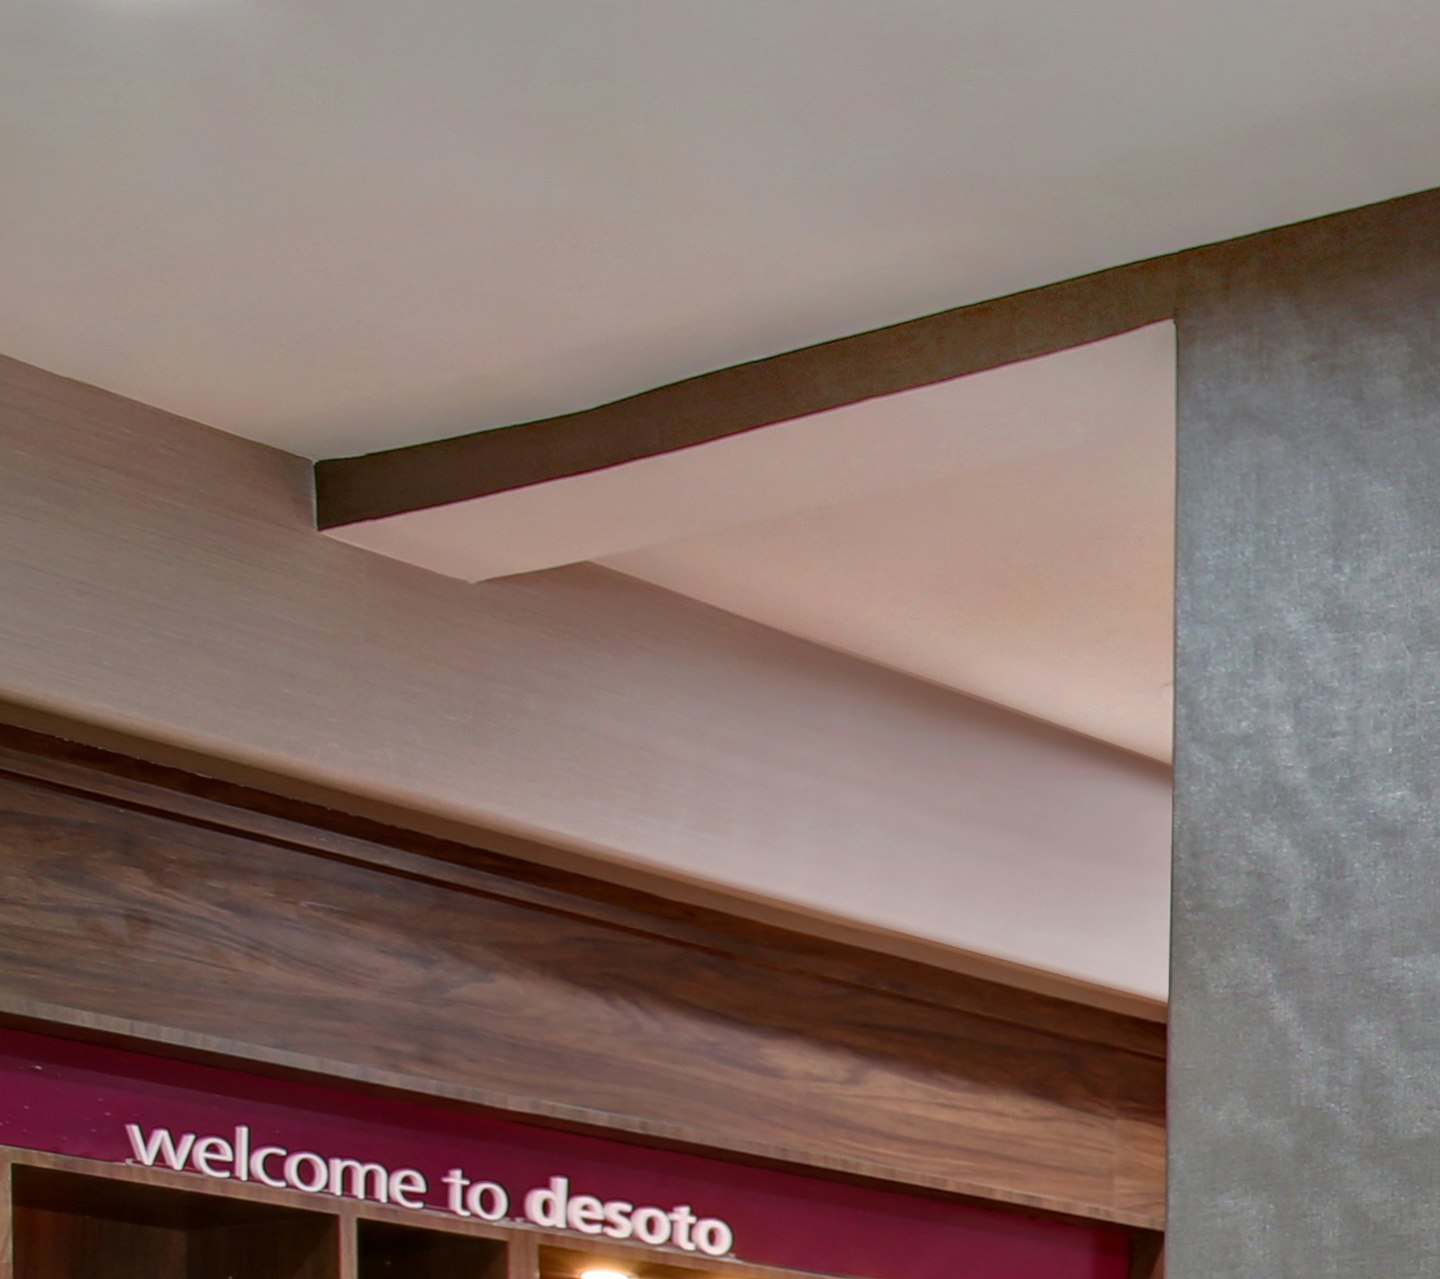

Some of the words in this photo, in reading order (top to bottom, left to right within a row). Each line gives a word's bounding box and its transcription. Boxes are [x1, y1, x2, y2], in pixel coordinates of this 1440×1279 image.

[125, 1123, 427, 1209] welcome
[443, 1168, 509, 1223] to
[525, 1176, 734, 1257] desoto
